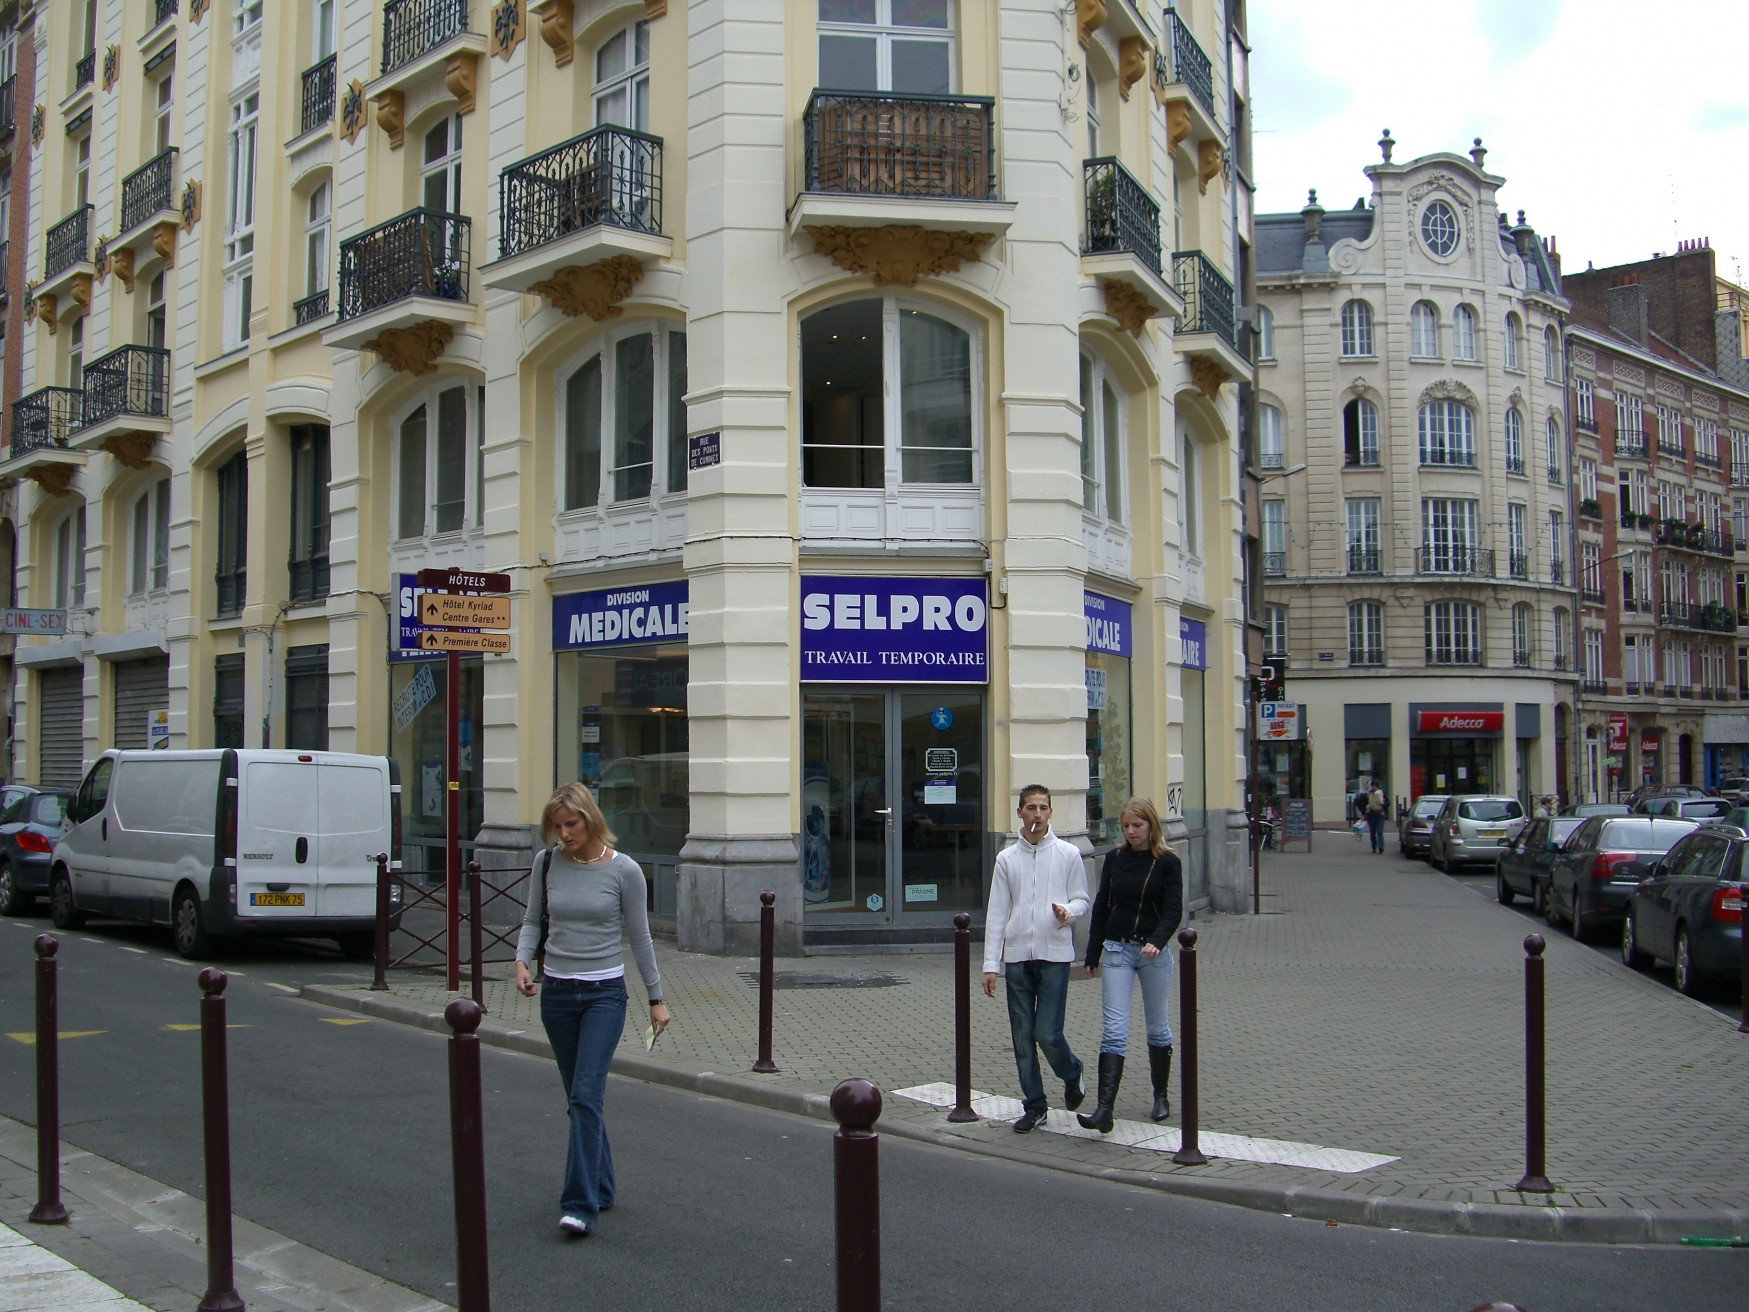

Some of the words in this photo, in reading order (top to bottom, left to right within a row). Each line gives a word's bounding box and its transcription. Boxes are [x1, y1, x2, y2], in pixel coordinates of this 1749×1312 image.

[700, 437, 709, 445] RUE
[692, 448, 700, 457] DES
[703, 445, 718, 454] PONTS
[448, 573, 486, 587] HÔTELS
[606, 590, 650, 606] DIVISION
[443, 599, 465, 609] Hôtel
[468, 601, 493, 612] Kyriad
[803, 593, 986, 632] SELPRO
[442, 612, 469, 622] Centre
[472, 613, 495, 624] Gares
[569, 603, 689, 643] MEDICALE
[1086, 615, 1120, 651] DICALE
[443, 636, 478, 647] Première
[481, 638, 507, 648] Classe
[805, 650, 872, 664] TRAVAIL
[879, 652, 984, 665] TEMPORAIRE
[415, 666, 431, 691] POUR
[1440, 716, 1485, 728] Adecco
